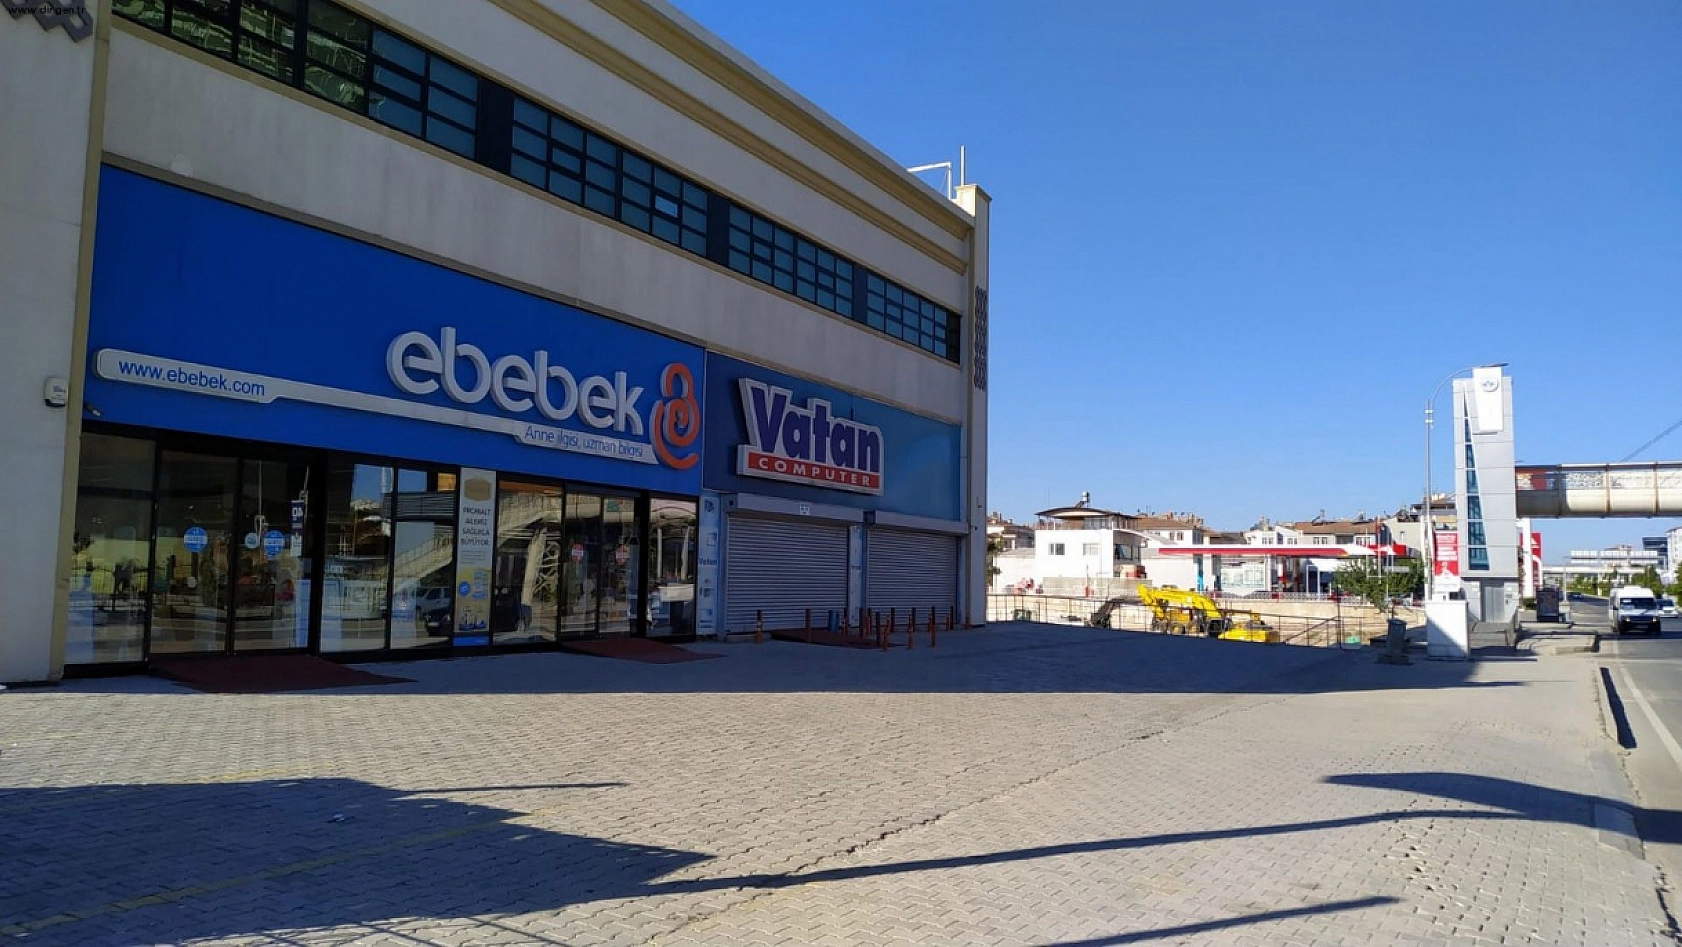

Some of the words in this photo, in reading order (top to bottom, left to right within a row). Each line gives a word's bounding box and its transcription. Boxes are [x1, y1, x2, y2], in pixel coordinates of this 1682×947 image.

[117, 359, 266, 397] www.ebebek.com
[386, 326, 645, 436] ebebek
[524, 425, 555, 443] Anne
[582, 437, 617, 454] uzman
[747, 384, 882, 474] Vatan
[757, 456, 872, 487] COMPUTER
